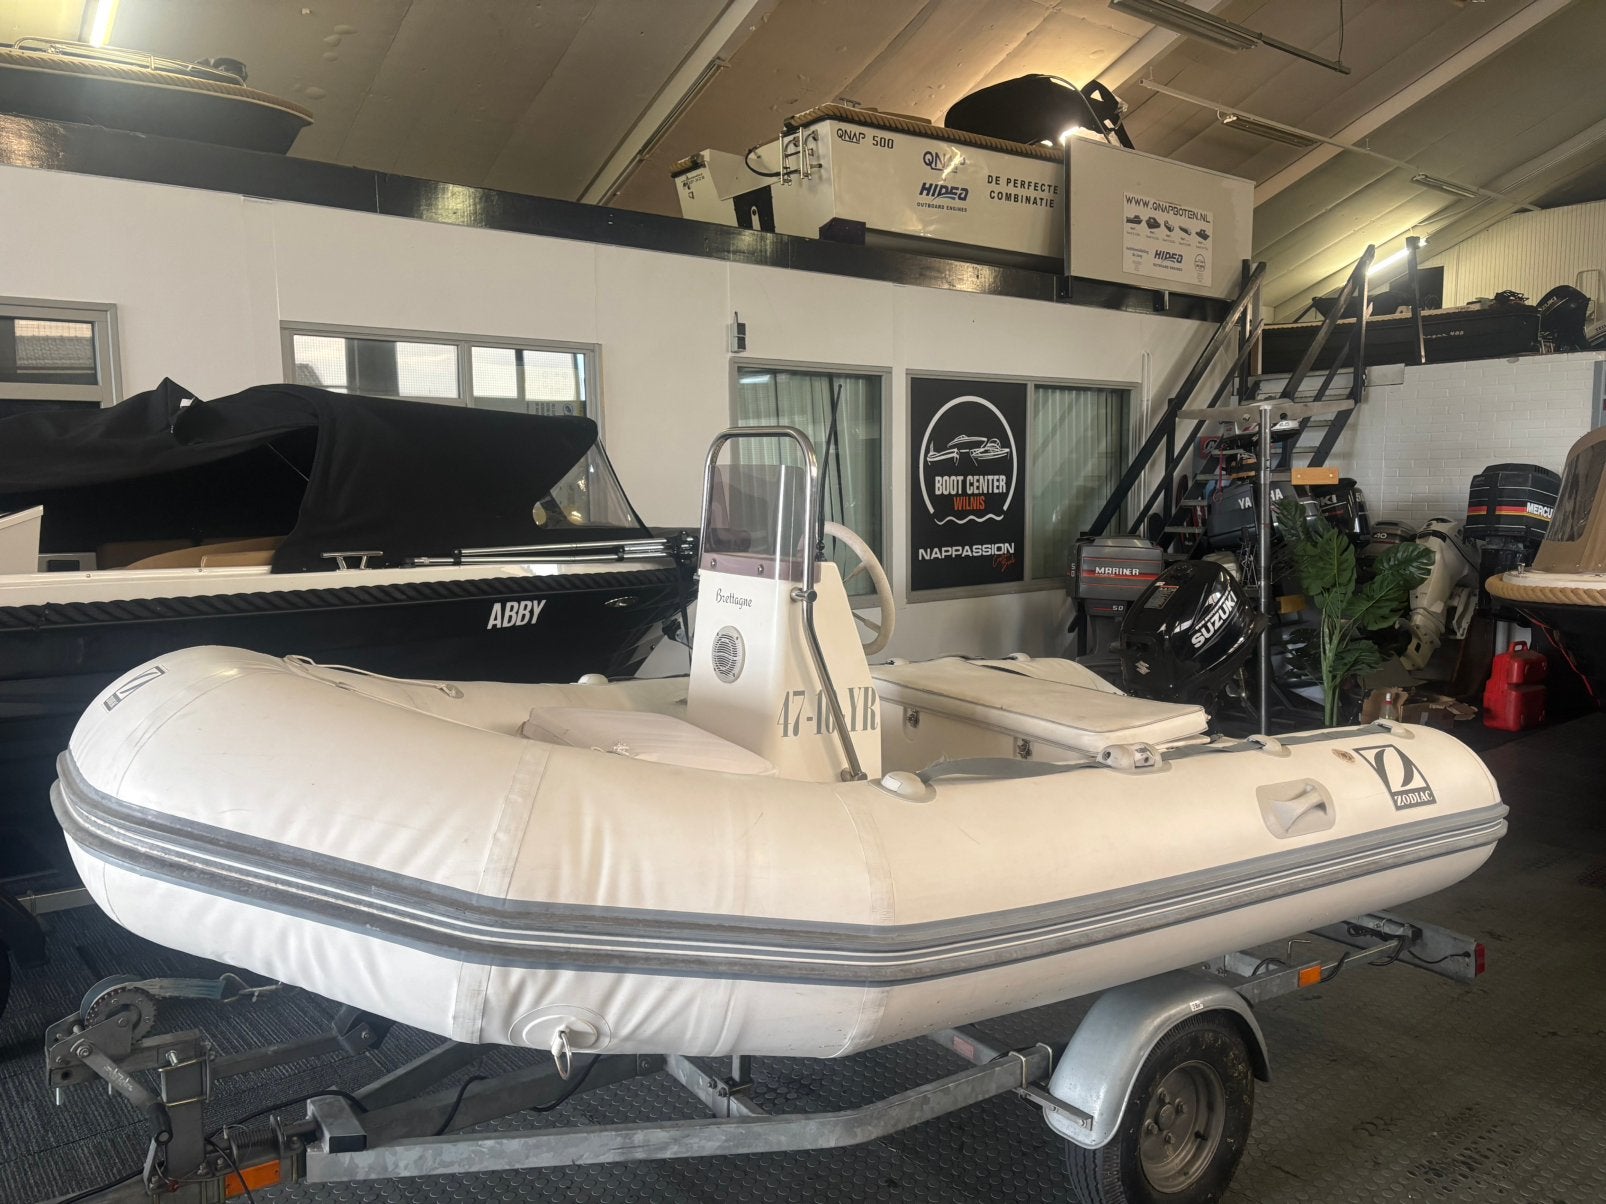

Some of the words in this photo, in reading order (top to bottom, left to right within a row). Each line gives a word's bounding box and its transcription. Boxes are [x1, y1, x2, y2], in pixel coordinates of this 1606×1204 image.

[836, 128, 866, 144] QNAP
[872, 135, 894, 149] 500
[987, 174, 1001, 185] DE
[1006, 177, 1059, 194] PERFECTE
[989, 190, 1055, 208] COMBINATIE
[1125, 195, 1211, 224] WWW.QNAPBOTEN.NL
[934, 475, 964, 495] BOOT
[966, 474, 1007, 494] CENTER
[953, 495, 986, 511] WILNIS
[1526, 501, 1554, 519] MERCU
[918, 542, 1015, 561] NAPPASSION
[1095, 566, 1140, 576] MARINER
[716, 588, 753, 610] Brettagne
[487, 599, 547, 630] ABBY
[1191, 590, 1238, 648] SUZUKI
[1394, 790, 1433, 806] ZODIAC
